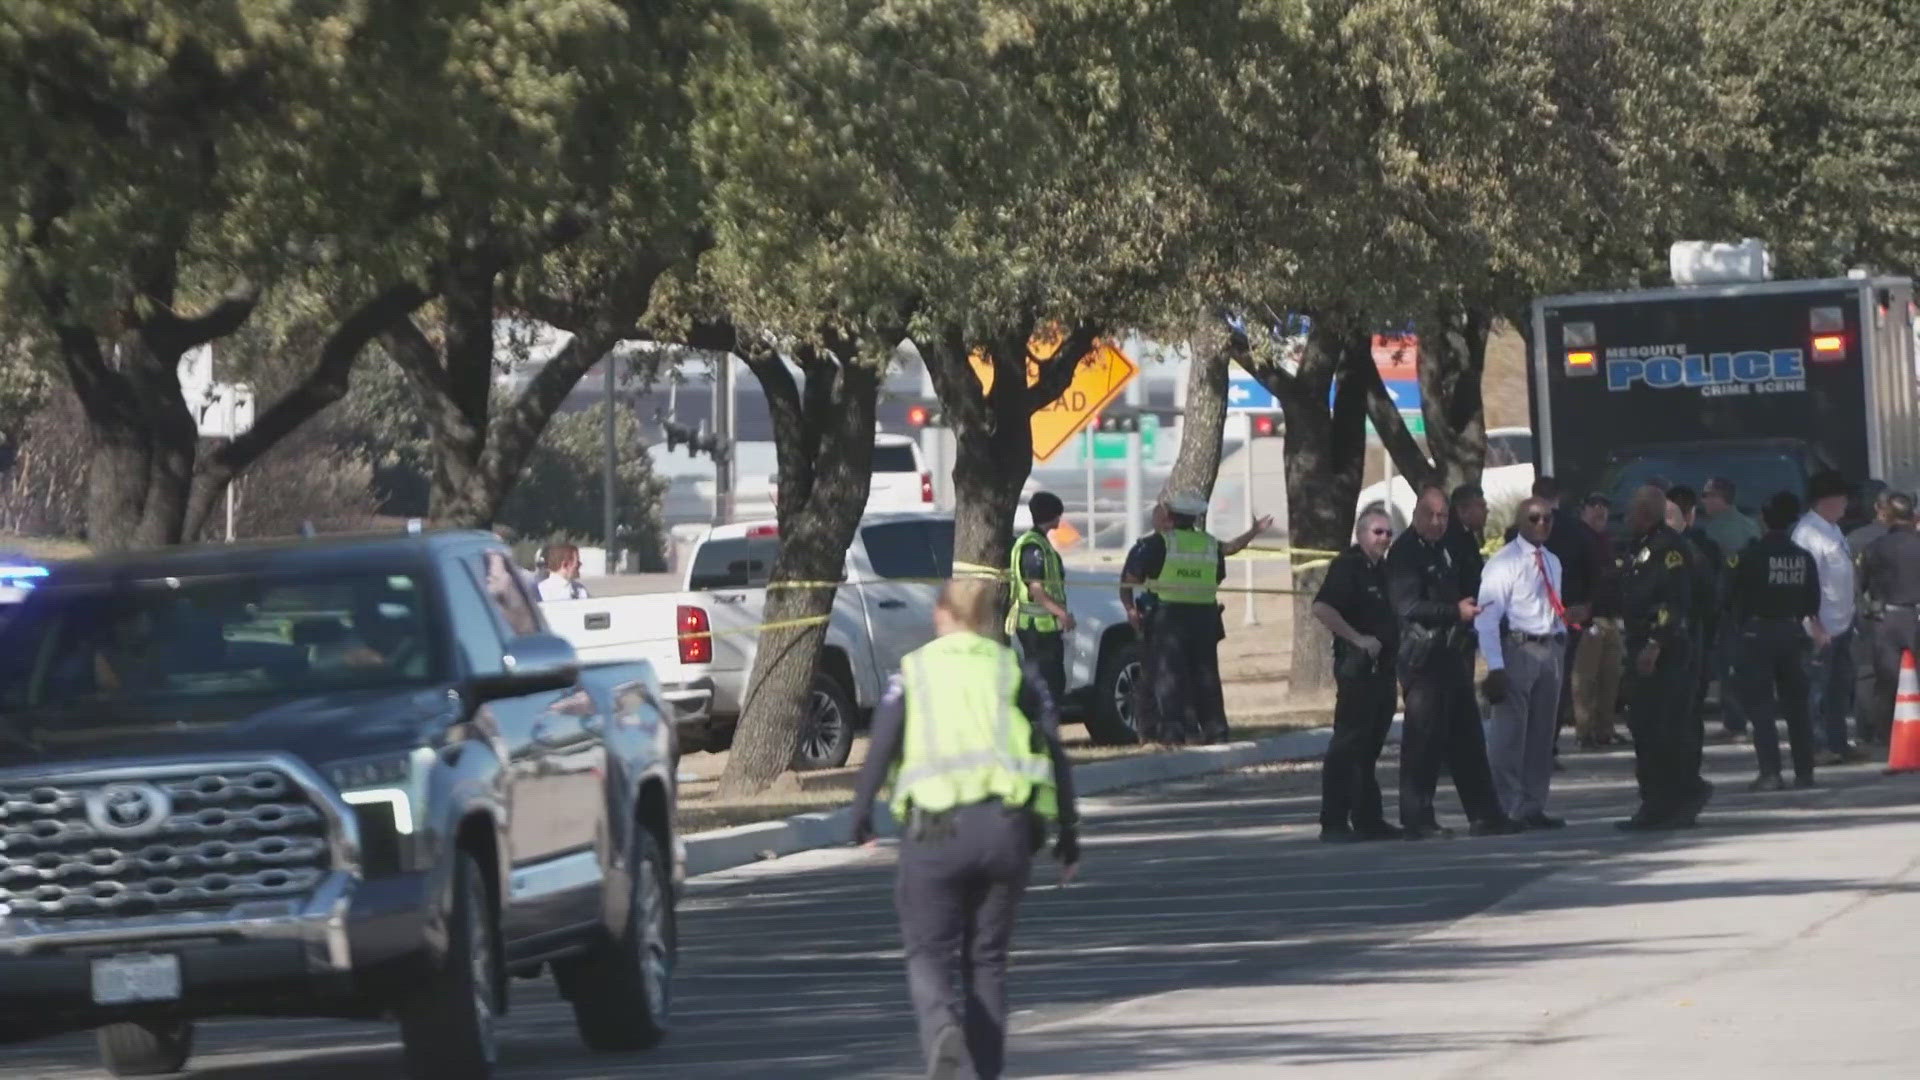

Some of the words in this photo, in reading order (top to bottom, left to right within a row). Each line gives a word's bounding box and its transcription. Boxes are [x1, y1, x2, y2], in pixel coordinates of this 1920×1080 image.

[1606, 344, 1687, 358] MESQUITE
[1606, 349, 1805, 391] POLICE
[1701, 383, 1750, 397] CRIME
[1755, 380, 1806, 394] SCENE
[1769, 556, 1806, 569] DALLAS
[1176, 568, 1202, 578] POLICE
[1768, 570, 1806, 584] POLICE
